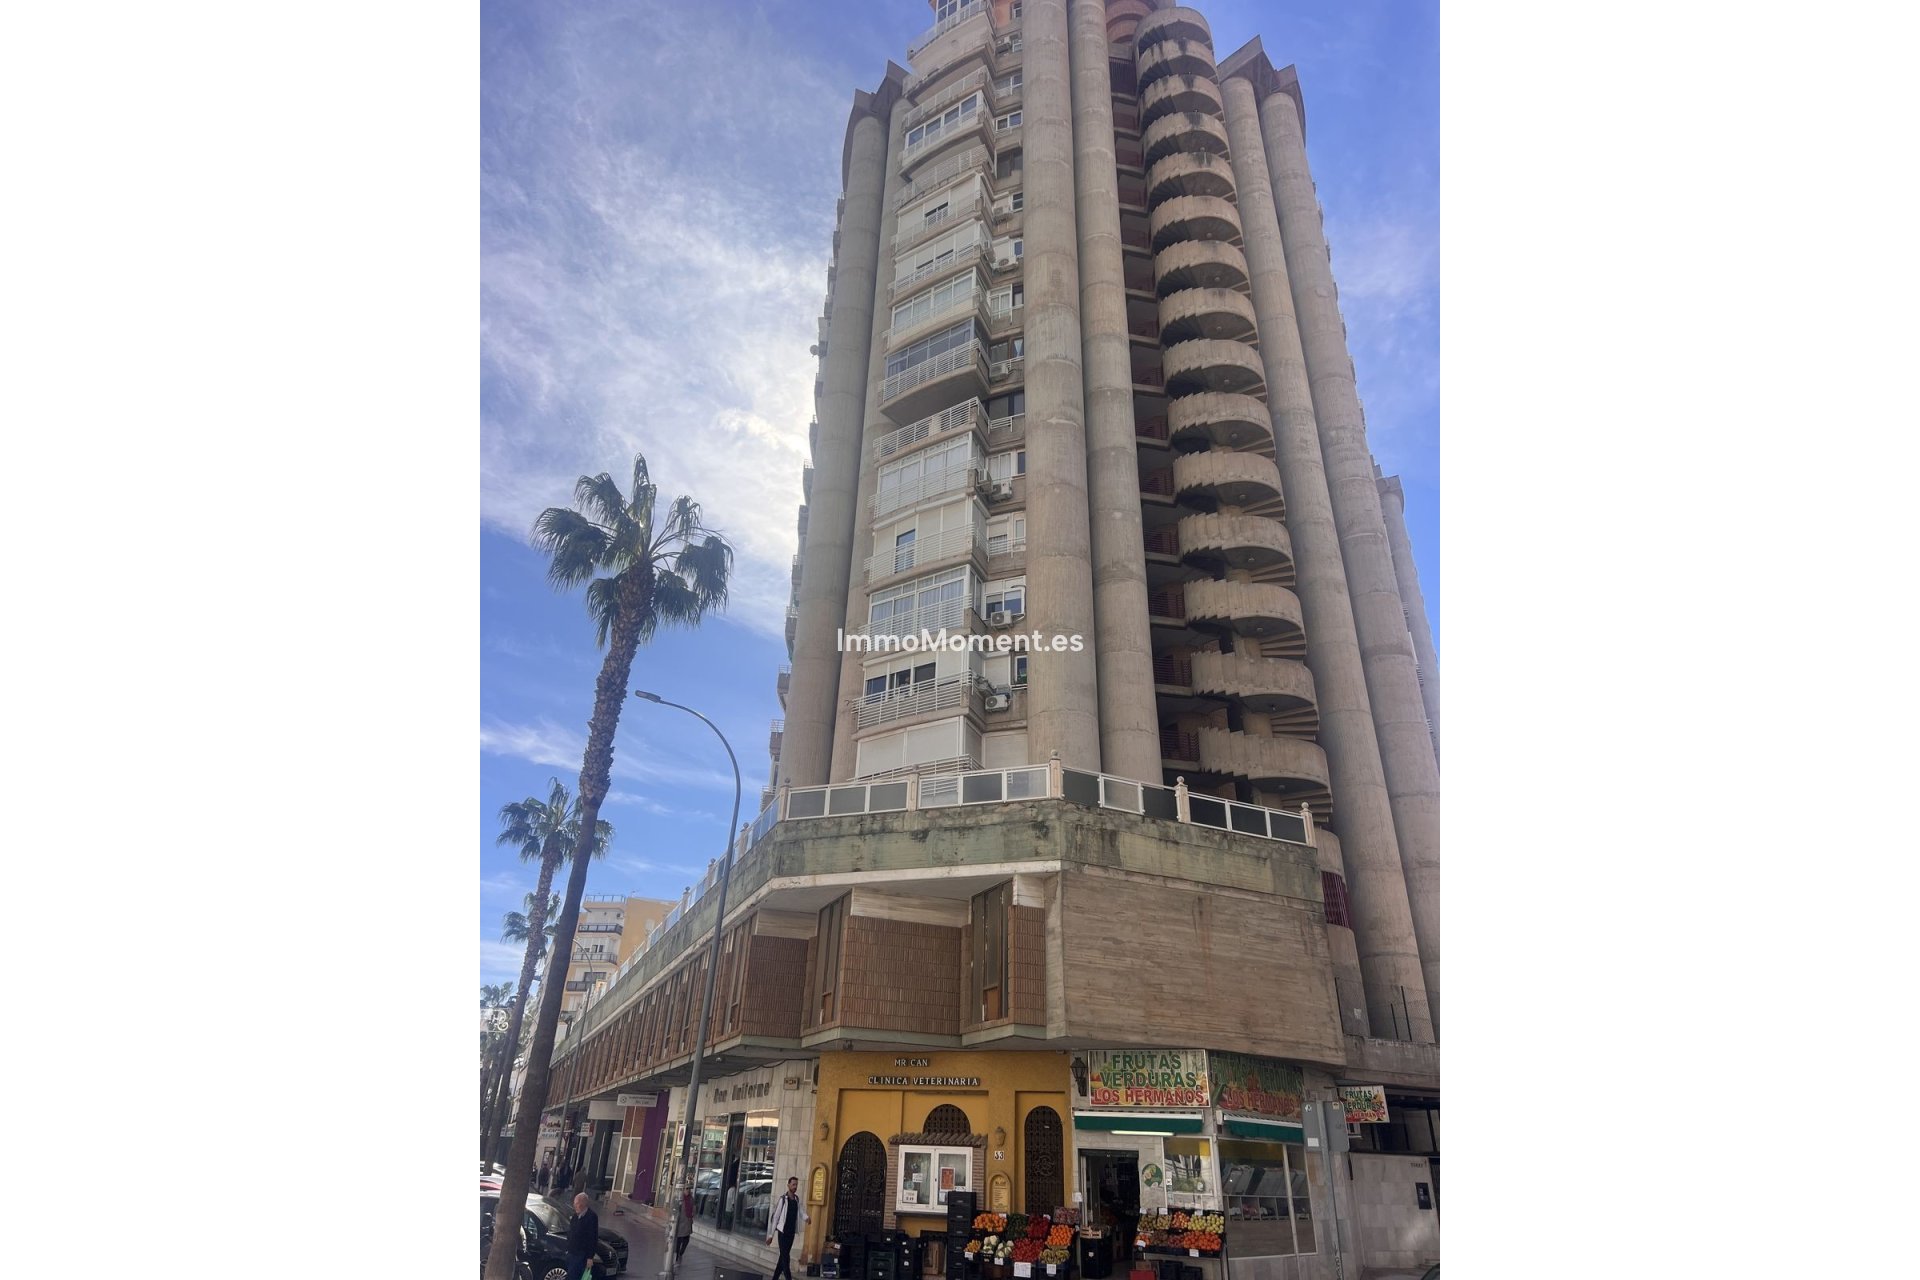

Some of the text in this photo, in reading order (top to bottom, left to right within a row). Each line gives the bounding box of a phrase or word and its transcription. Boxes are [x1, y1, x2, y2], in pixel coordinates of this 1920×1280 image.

[894, 1058, 929, 1067] MR CAN
[1112, 1054, 1182, 1070] FRUTAS
[868, 1076, 979, 1086] CLINICA VETERINARIA
[1100, 1071, 1197, 1088] VERDURAS
[1094, 1089, 1120, 1103] LOS
[1344, 1090, 1373, 1099] FRUTAS
